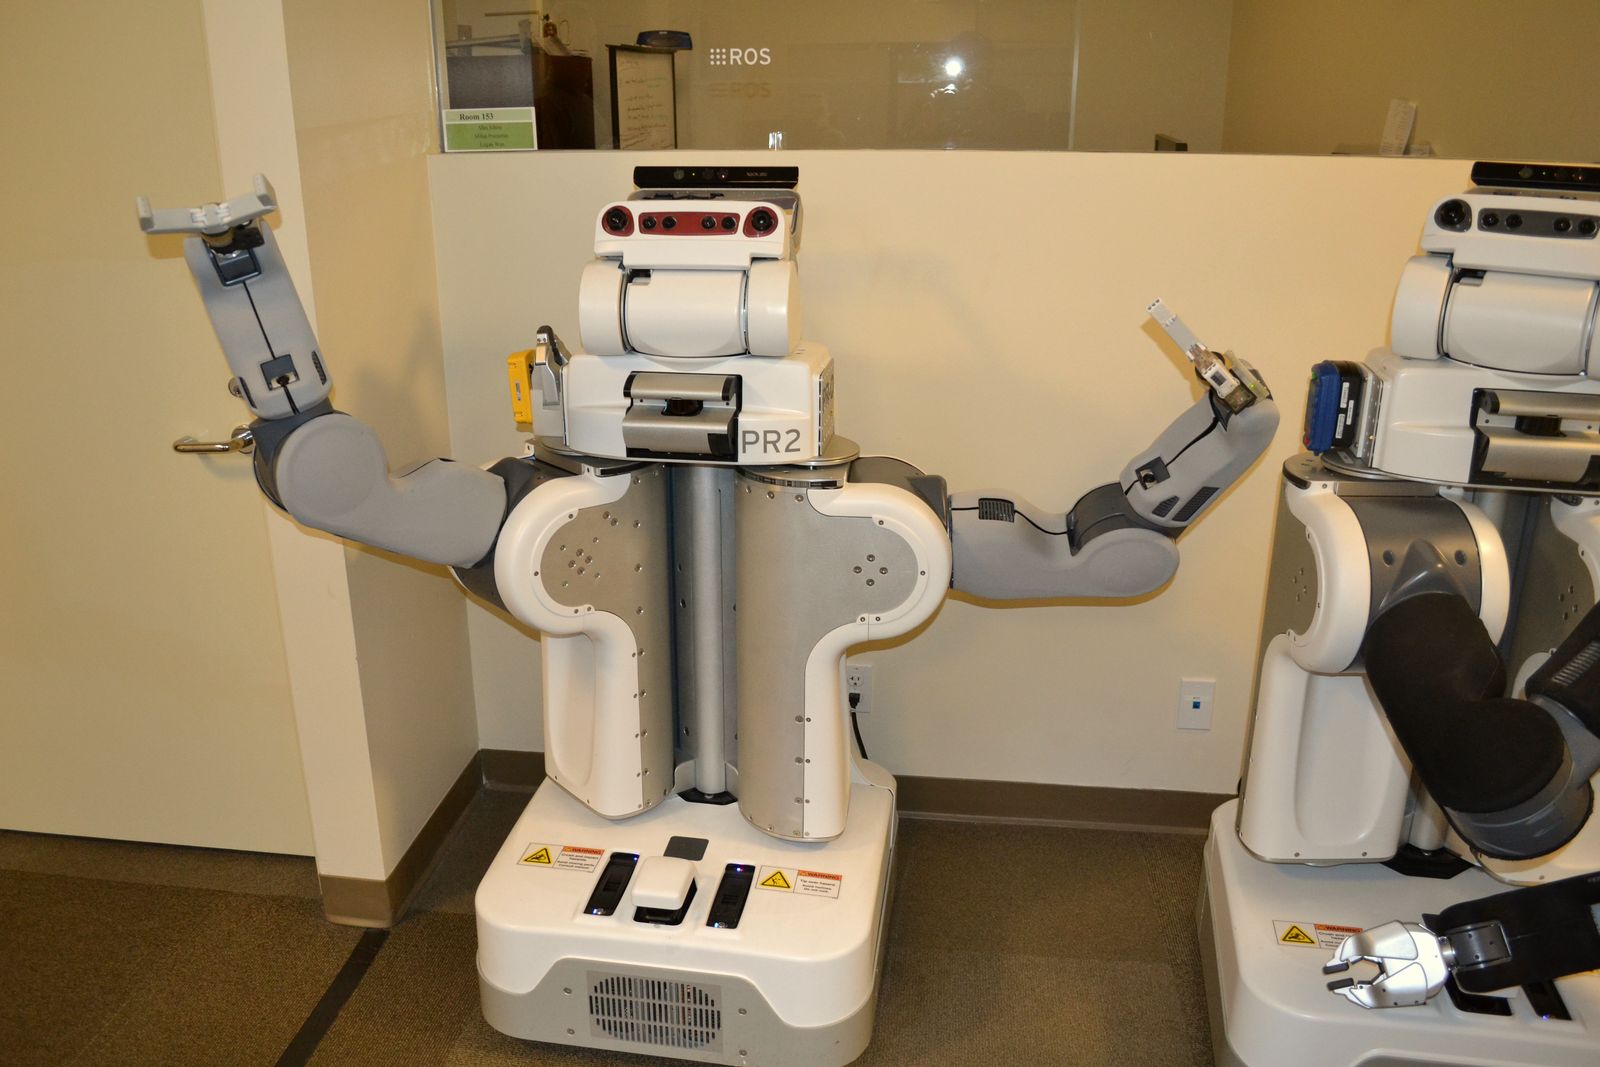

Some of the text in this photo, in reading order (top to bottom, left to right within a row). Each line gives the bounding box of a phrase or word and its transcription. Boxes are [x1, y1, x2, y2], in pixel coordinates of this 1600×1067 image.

[730, 48, 771, 65] ROS
[459, 113, 480, 121] Room
[742, 428, 800, 454] PR2
